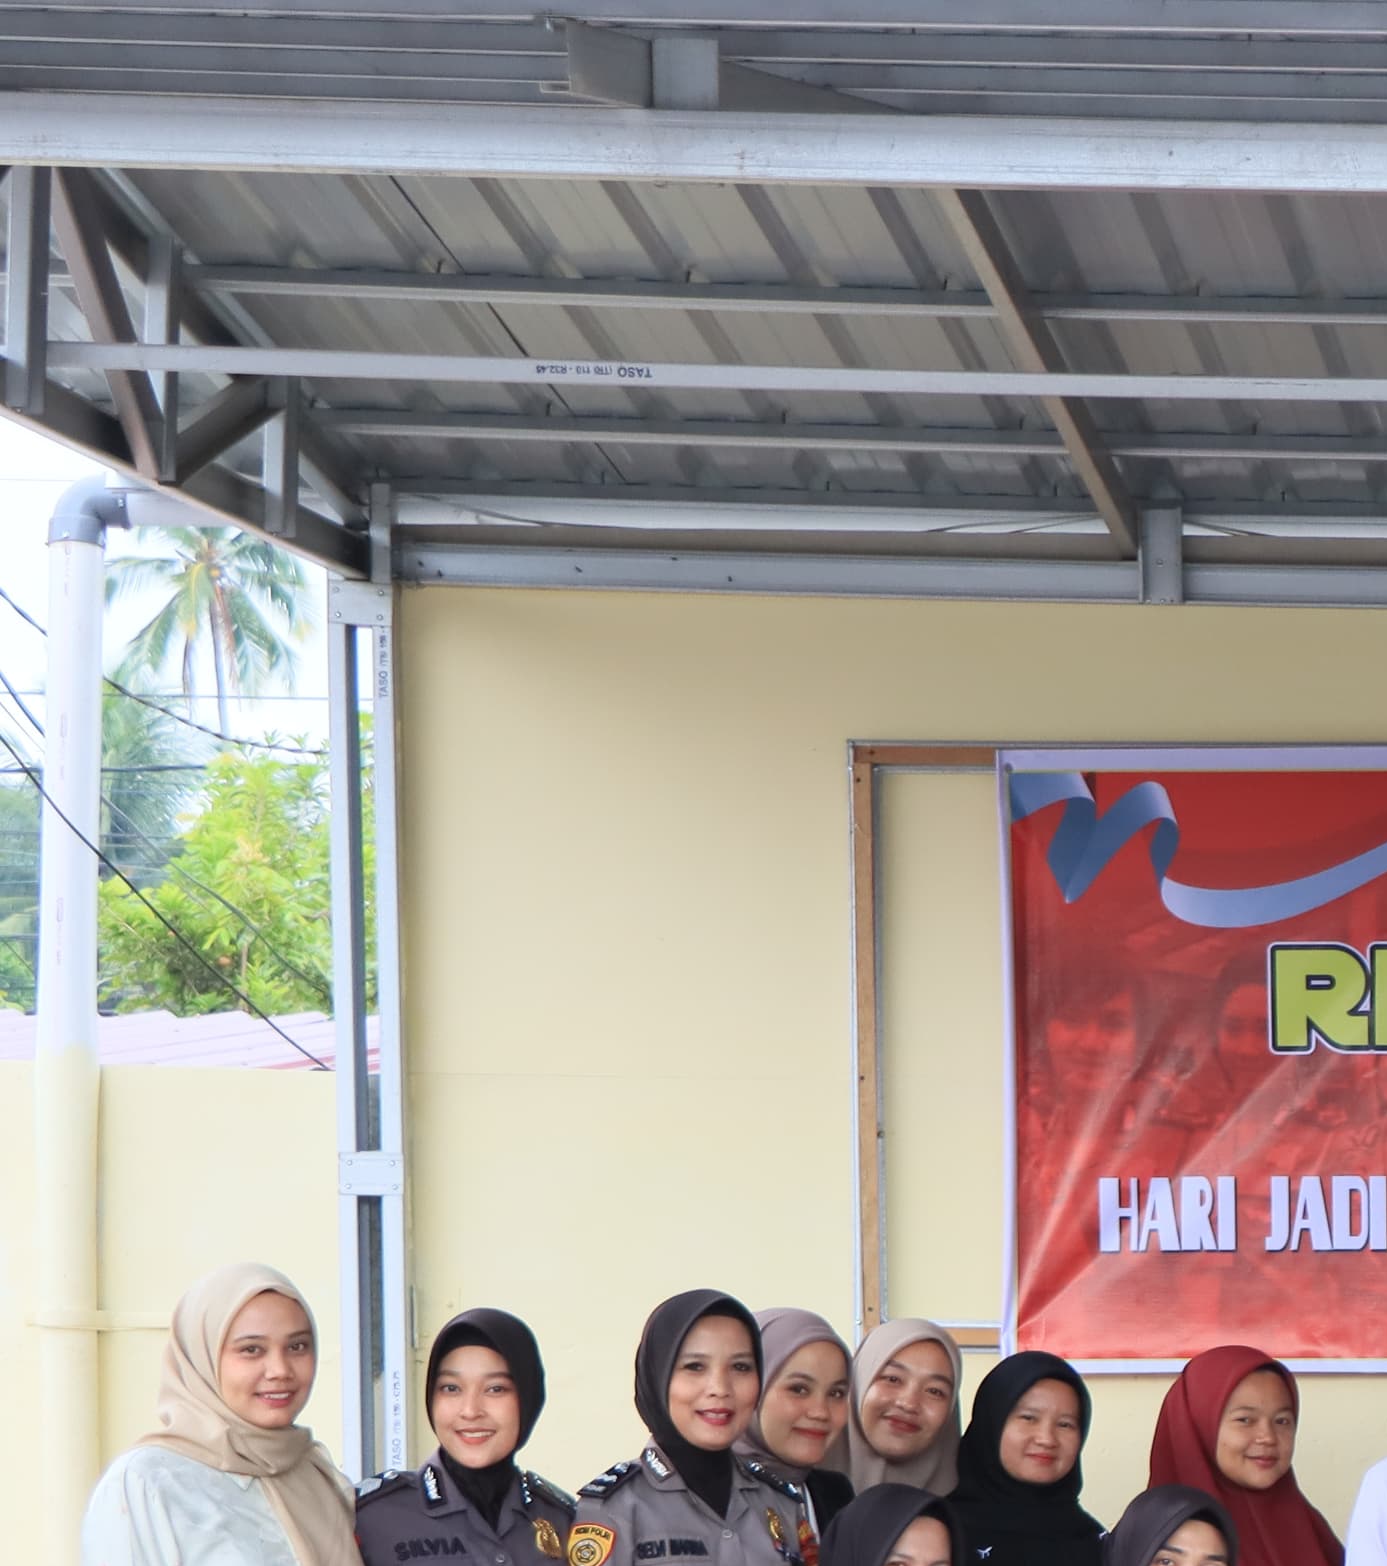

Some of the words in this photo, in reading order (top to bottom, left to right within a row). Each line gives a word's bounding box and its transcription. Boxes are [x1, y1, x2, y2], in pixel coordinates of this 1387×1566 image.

[617, 366, 652, 378] TASO
[378, 671, 388, 698] TASO
[1099, 1176, 1236, 1252] HARI
[1265, 1176, 1387, 1251] JADI
[394, 1536, 468, 1561] SILVIA
